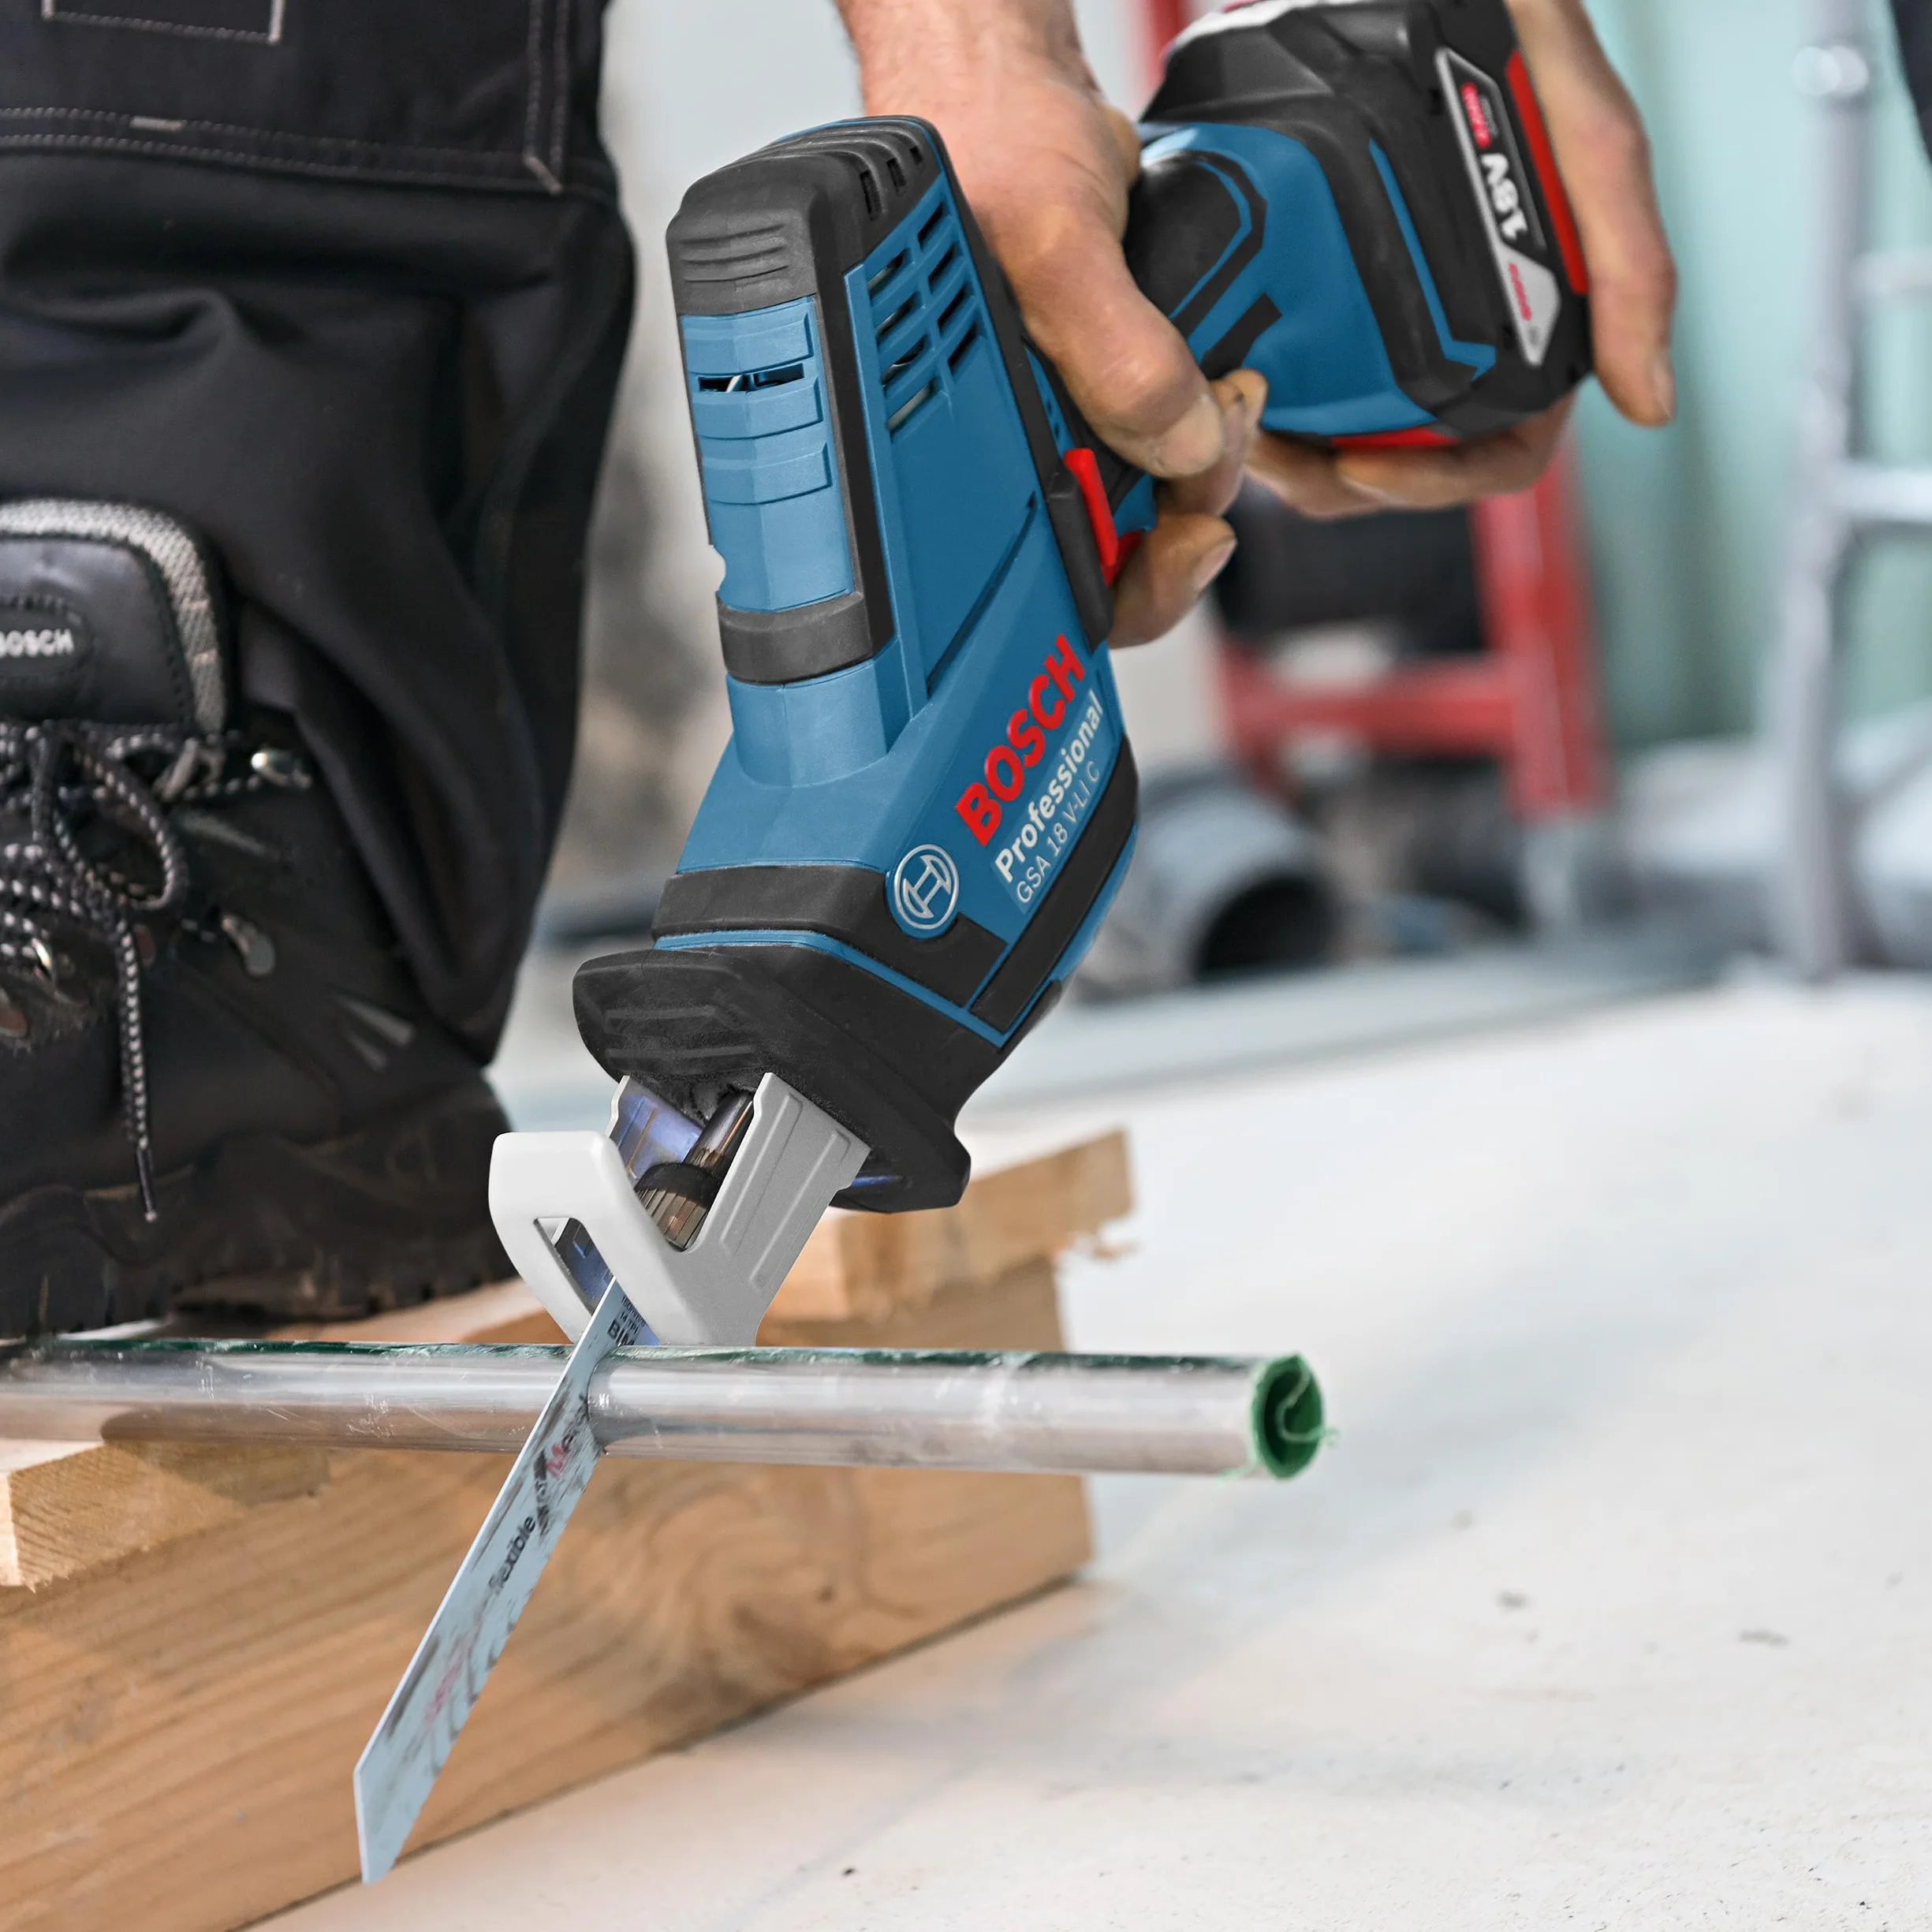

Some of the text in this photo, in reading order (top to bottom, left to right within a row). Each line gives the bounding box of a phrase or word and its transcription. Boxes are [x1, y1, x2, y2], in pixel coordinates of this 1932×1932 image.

[1481, 153, 1528, 243] 18V
[954, 633, 1086, 847] BOSCH
[994, 688, 1104, 883] Professional
[1016, 854, 1052, 904] GSA
[1046, 822, 1069, 856] 18
[1085, 760, 1101, 784] C
